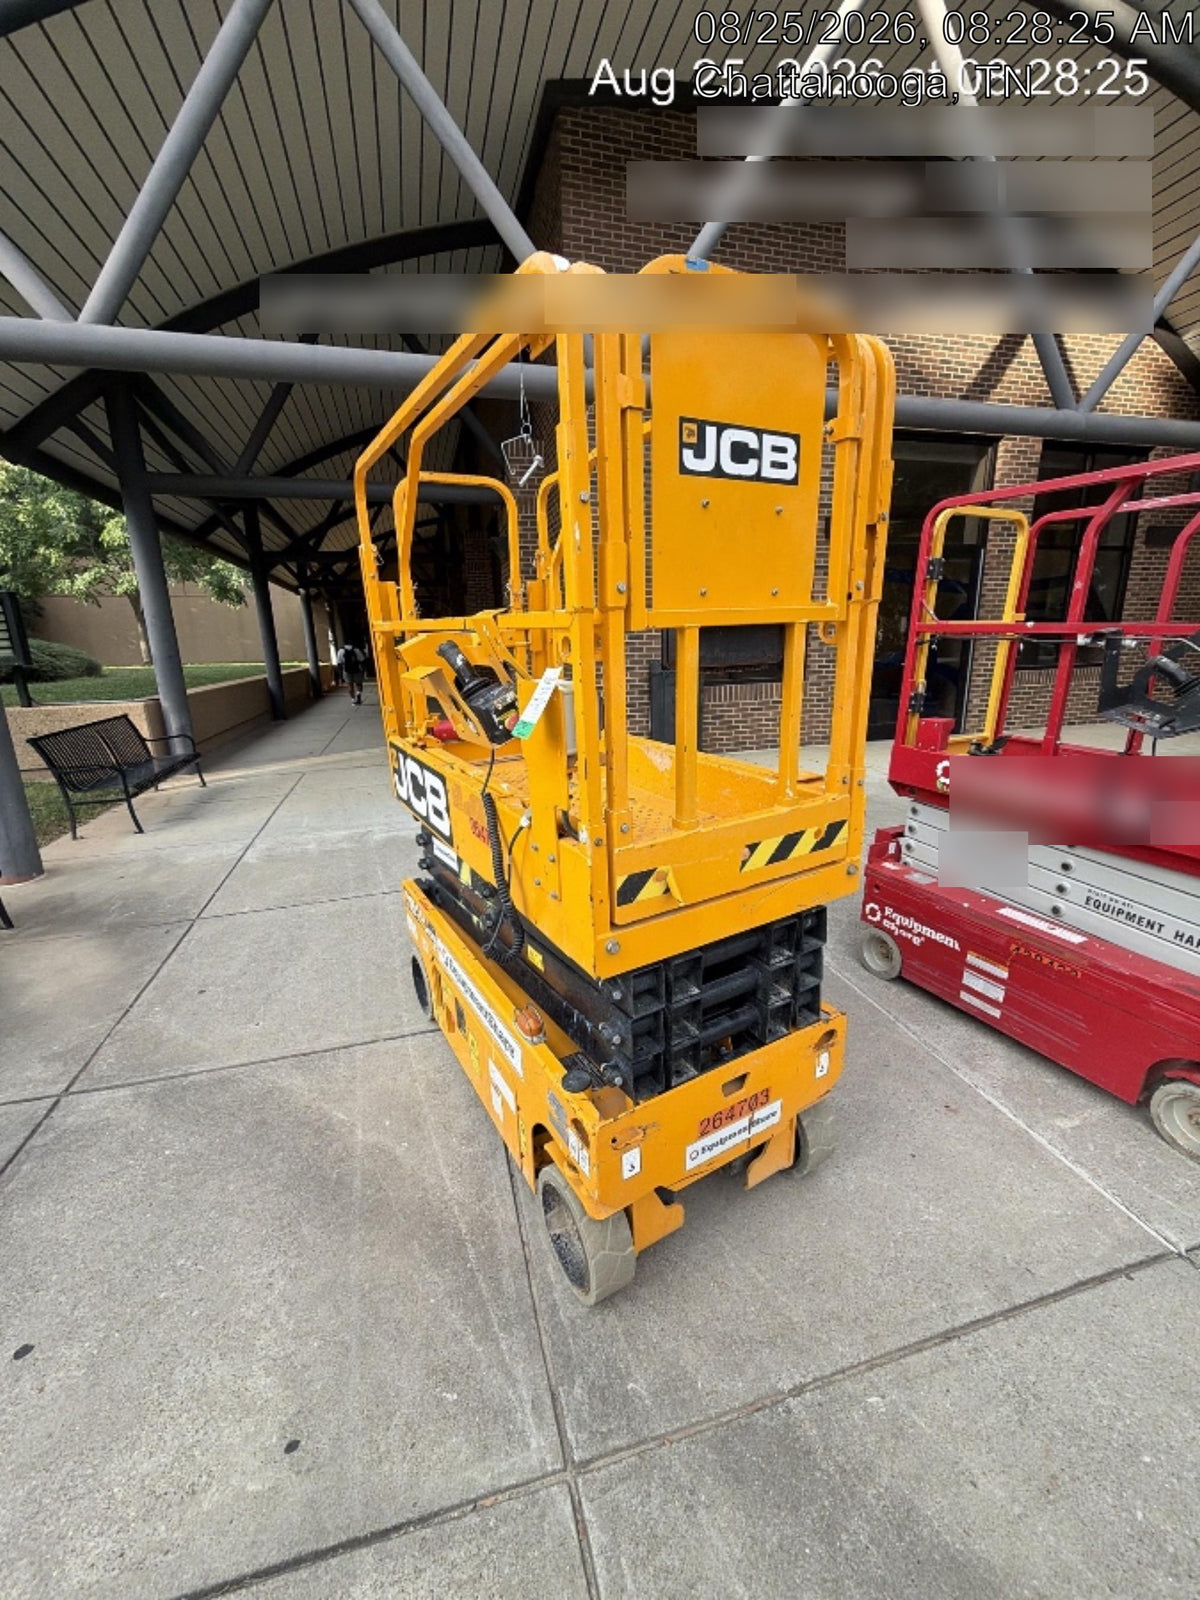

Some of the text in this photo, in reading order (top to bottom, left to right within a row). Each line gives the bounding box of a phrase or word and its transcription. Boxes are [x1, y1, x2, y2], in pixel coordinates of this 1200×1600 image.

[682, 424, 798, 481] JCB
[394, 751, 452, 837] JCB
[884, 906, 961, 952] Equipment
[1084, 895, 1166, 934] EQUIPMENT
[699, 1086, 770, 1137] 264703
